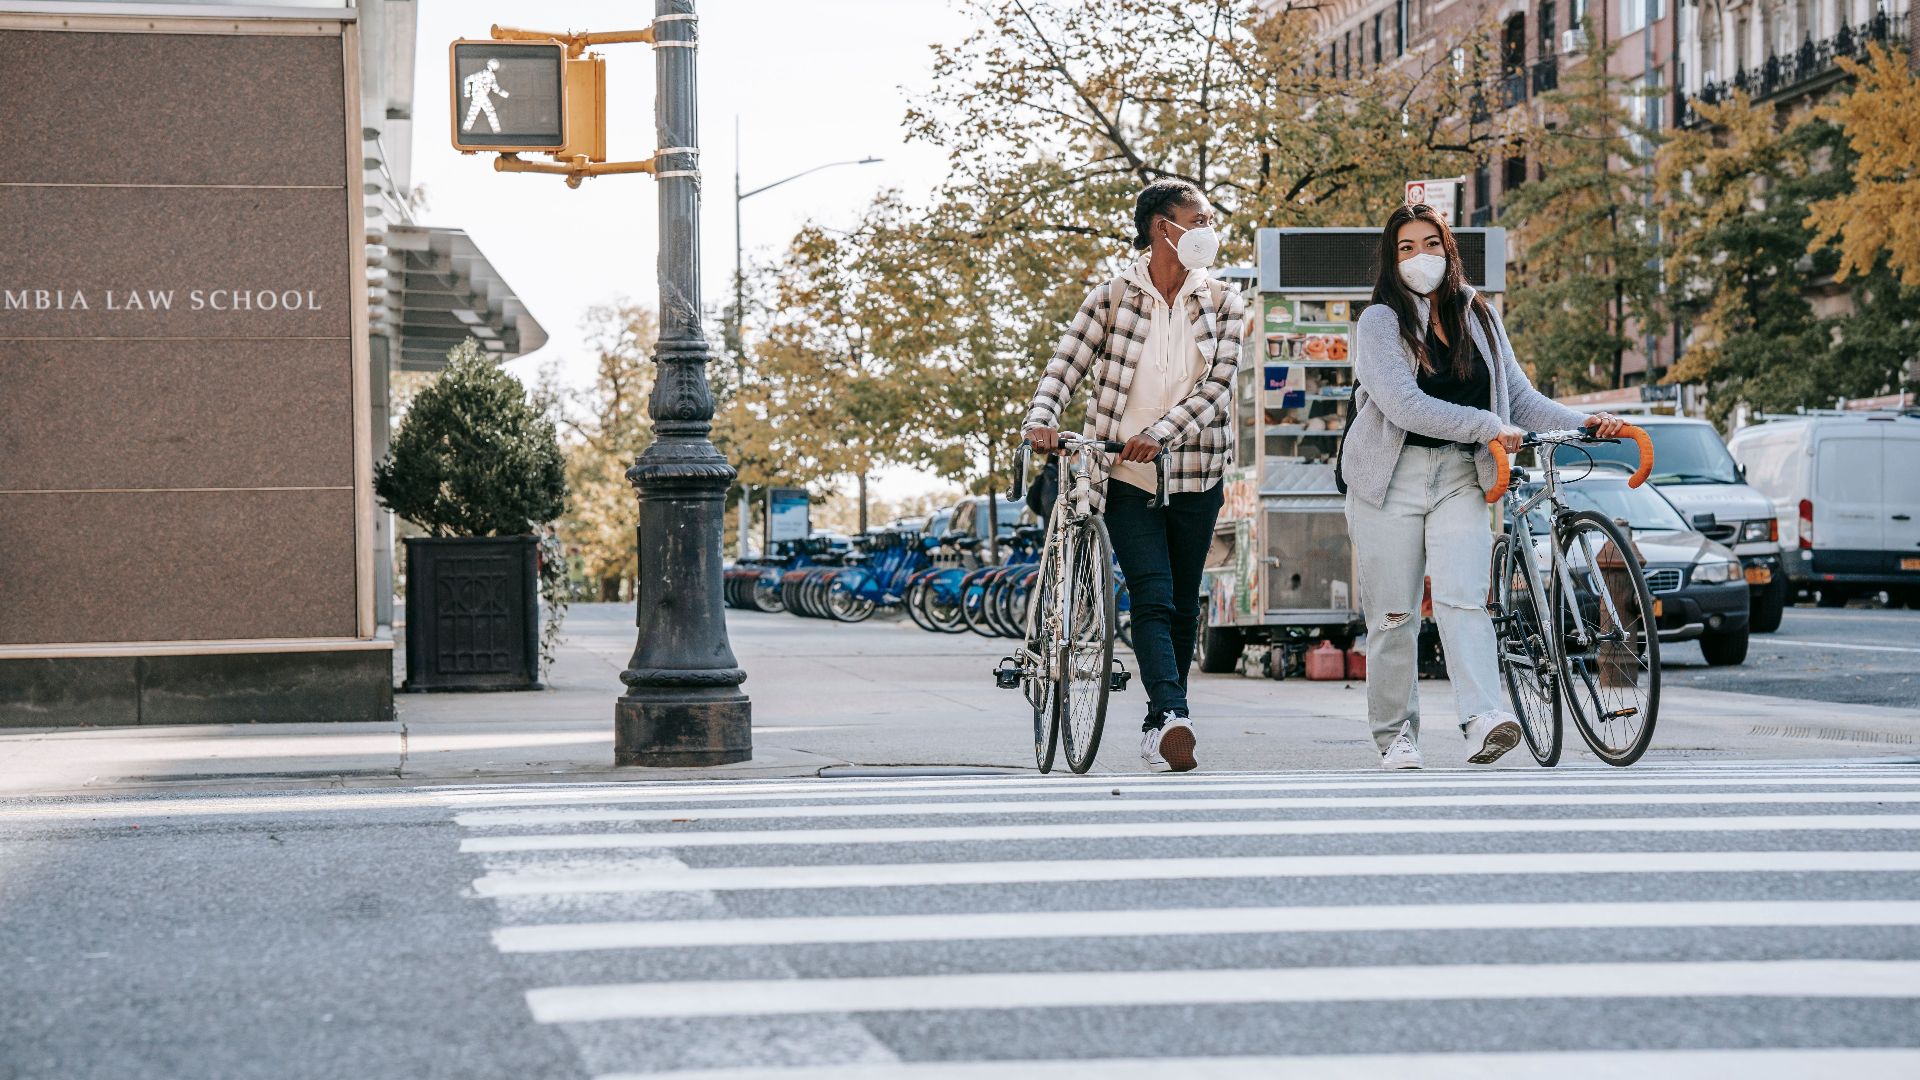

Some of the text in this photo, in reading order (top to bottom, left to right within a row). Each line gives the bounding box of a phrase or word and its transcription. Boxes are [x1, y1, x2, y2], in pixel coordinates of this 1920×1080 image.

[4, 289, 322, 311] MBIA LAW SCHOOL
